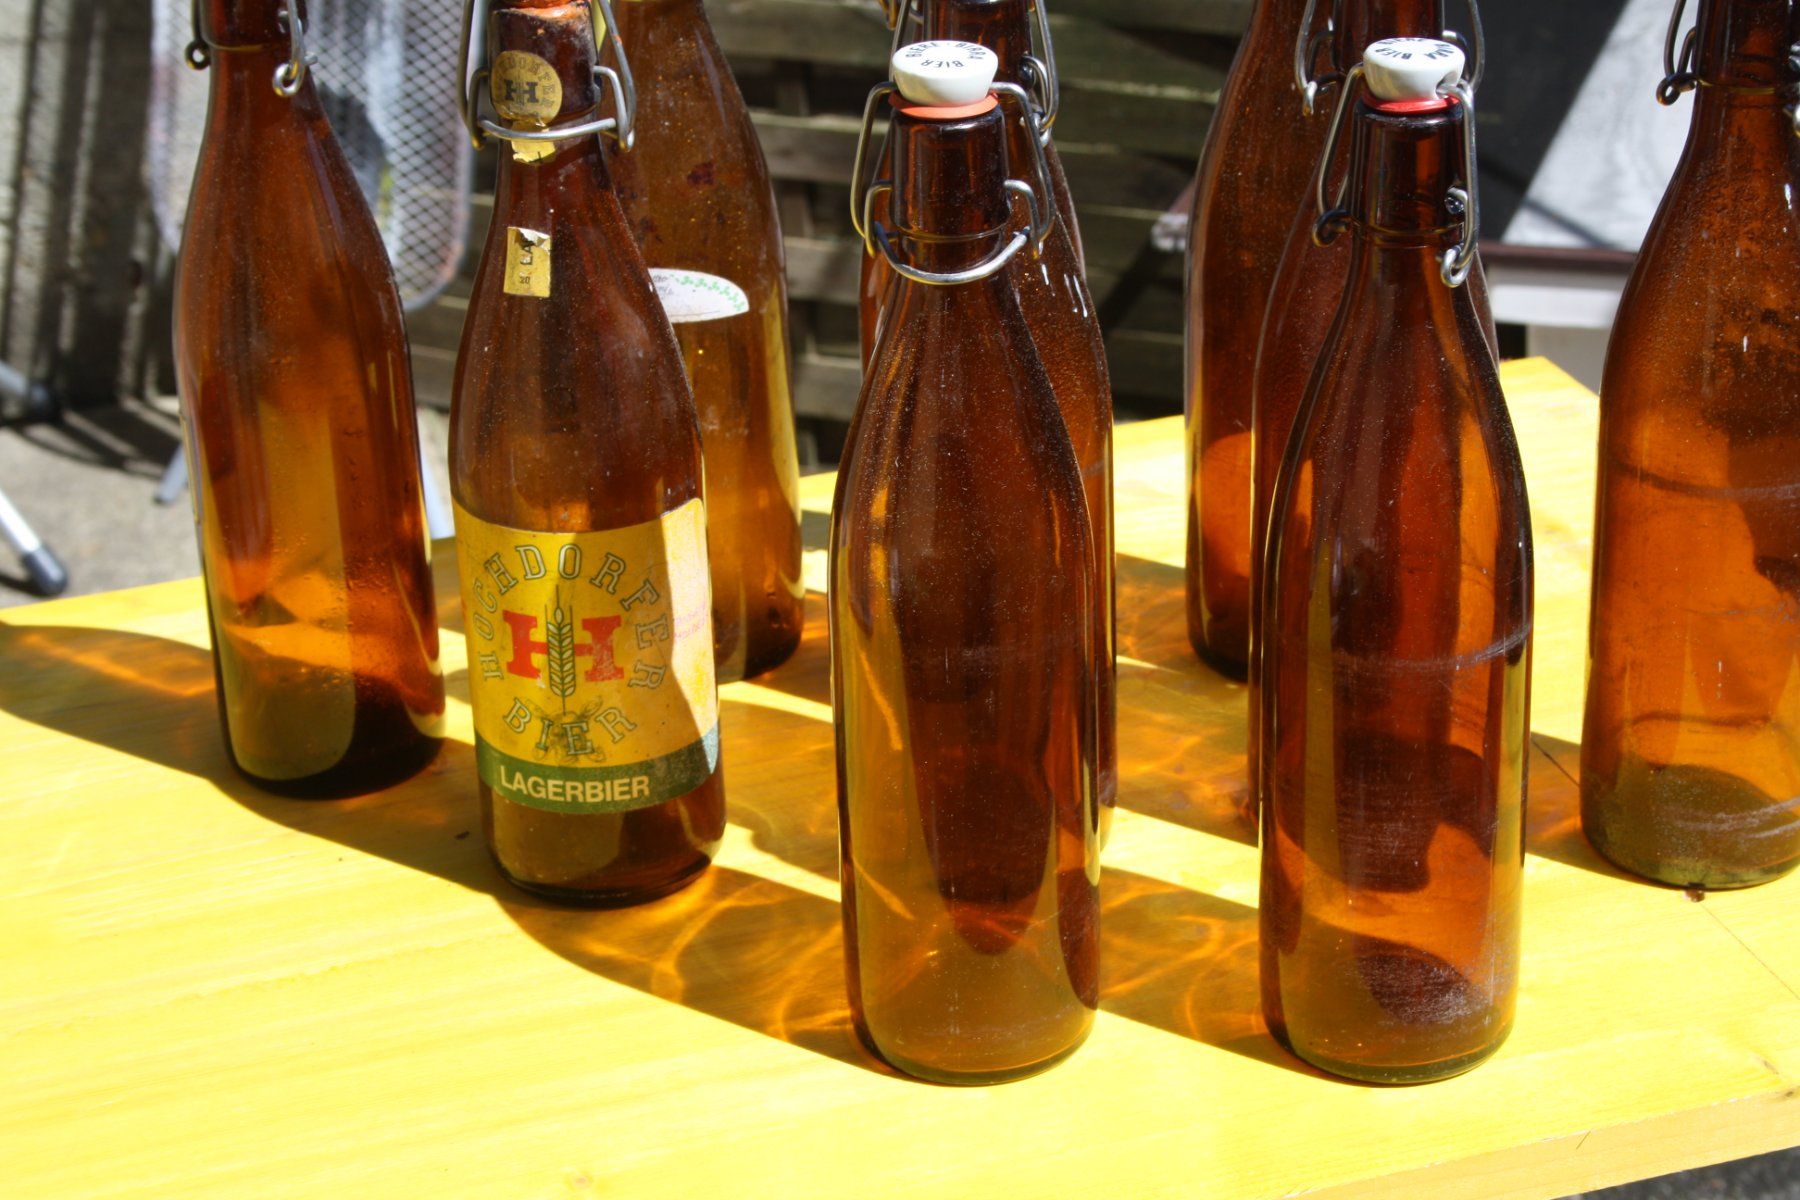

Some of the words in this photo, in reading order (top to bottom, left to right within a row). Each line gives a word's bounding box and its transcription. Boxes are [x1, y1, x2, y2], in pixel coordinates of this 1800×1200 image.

[920, 59, 965, 69] BIER
[1375, 47, 1413, 60] BIER
[504, 80, 539, 103] H
[472, 543, 670, 690] HOCHDORFER
[502, 609, 625, 683] H
[502, 697, 637, 756] BIER
[499, 765, 650, 803] LAGERBIER
